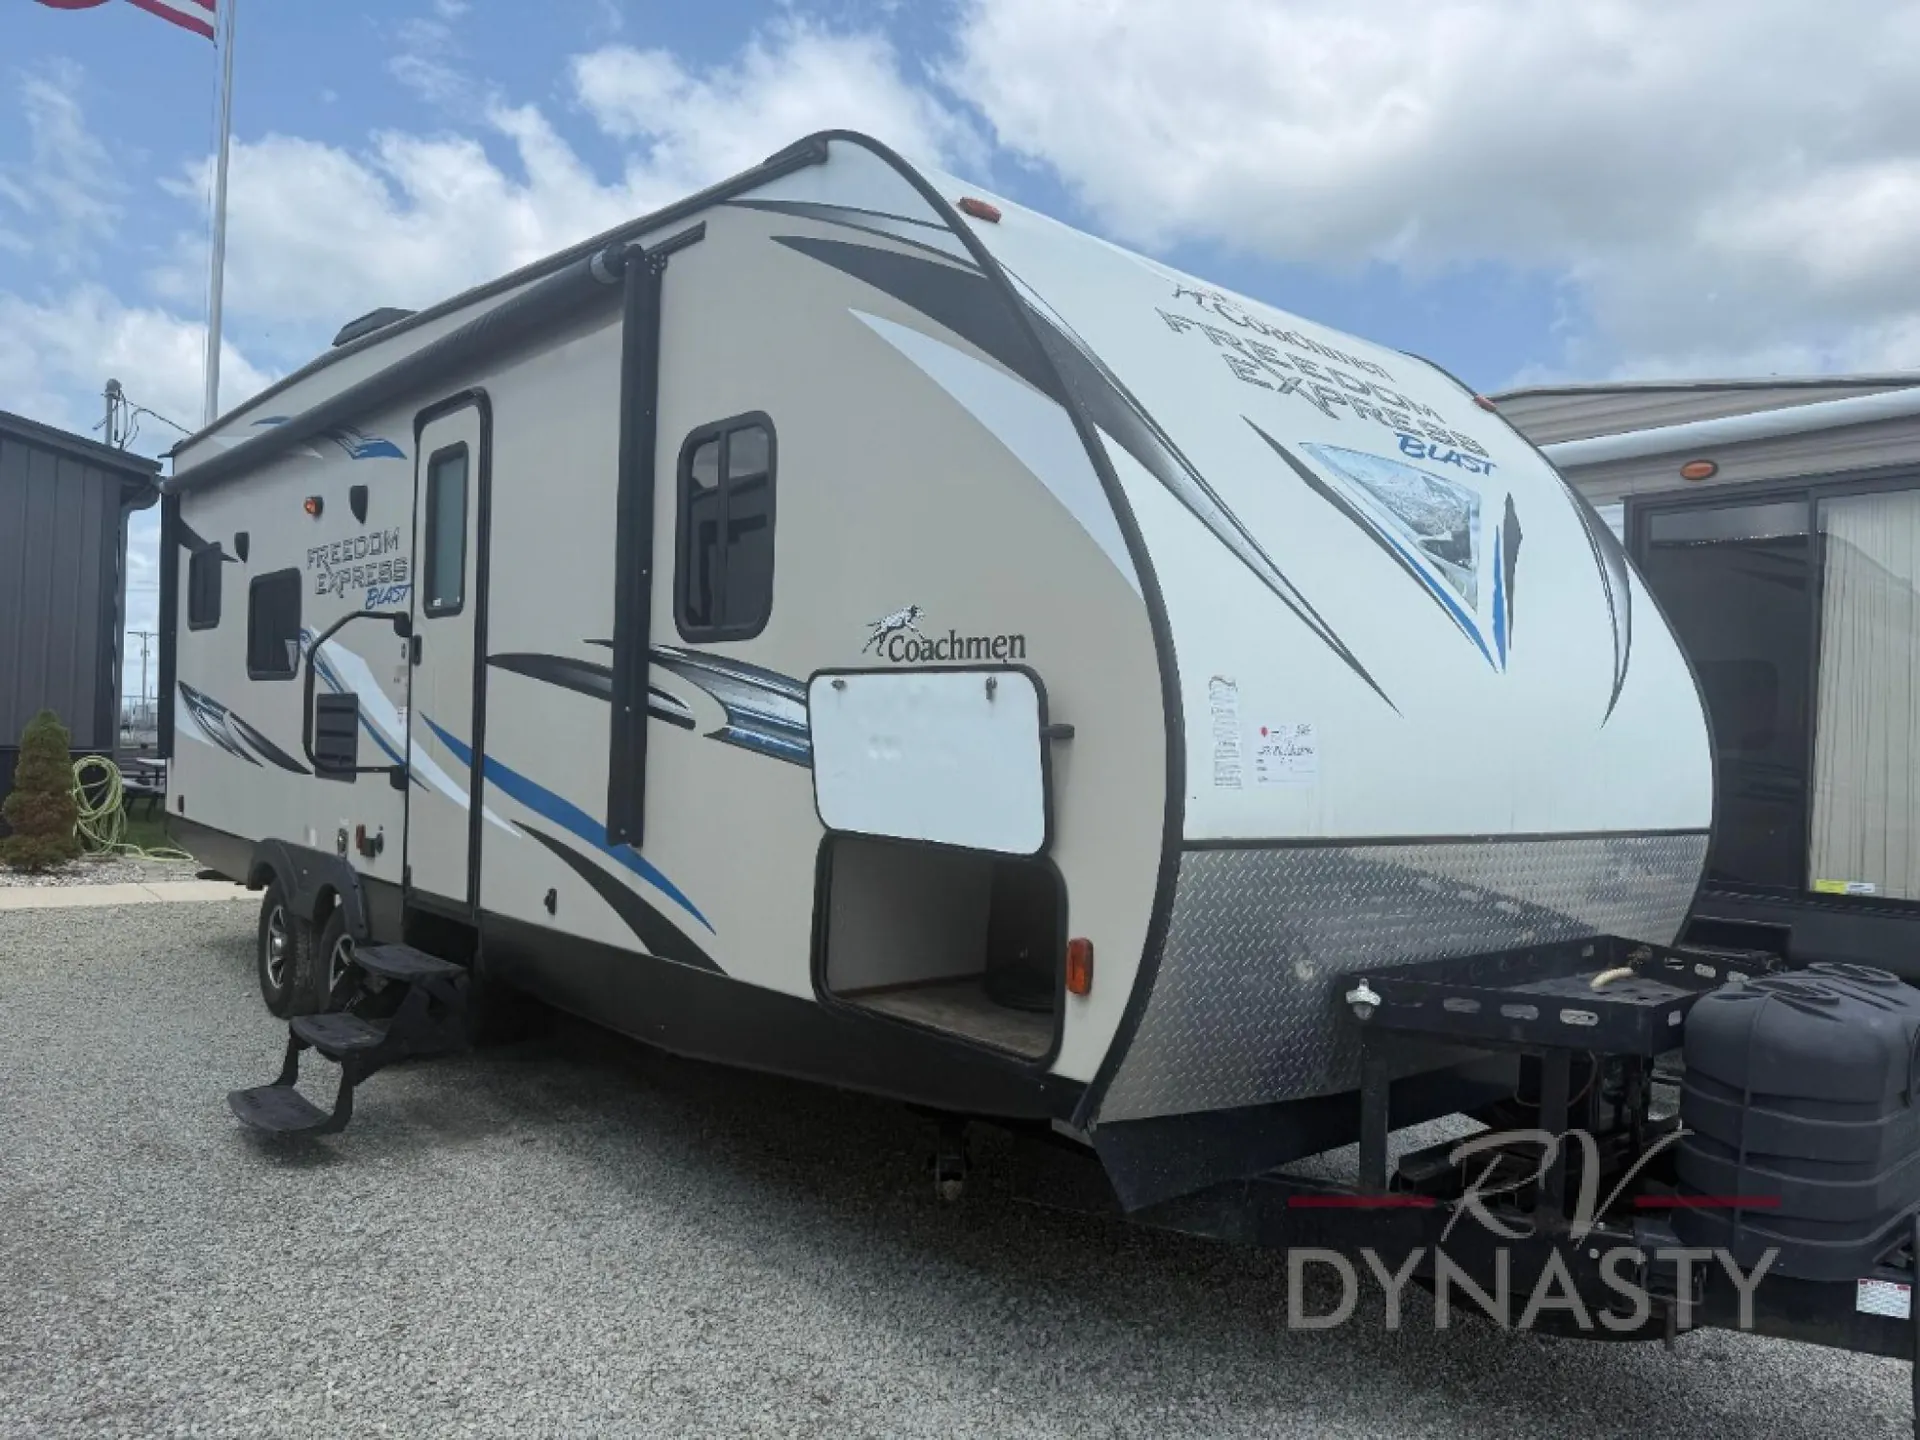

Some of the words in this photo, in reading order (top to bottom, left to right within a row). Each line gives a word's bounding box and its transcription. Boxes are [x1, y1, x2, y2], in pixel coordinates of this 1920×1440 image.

[1154, 306, 1447, 424] FREEDOM
[1221, 352, 1490, 458] EXPRESS
[1394, 431, 1498, 477] BLAST
[306, 526, 400, 570] FREEDOM
[314, 556, 408, 599] EXPRESS
[365, 583, 413, 611] BLAST
[888, 628, 1027, 663] Coachmen
